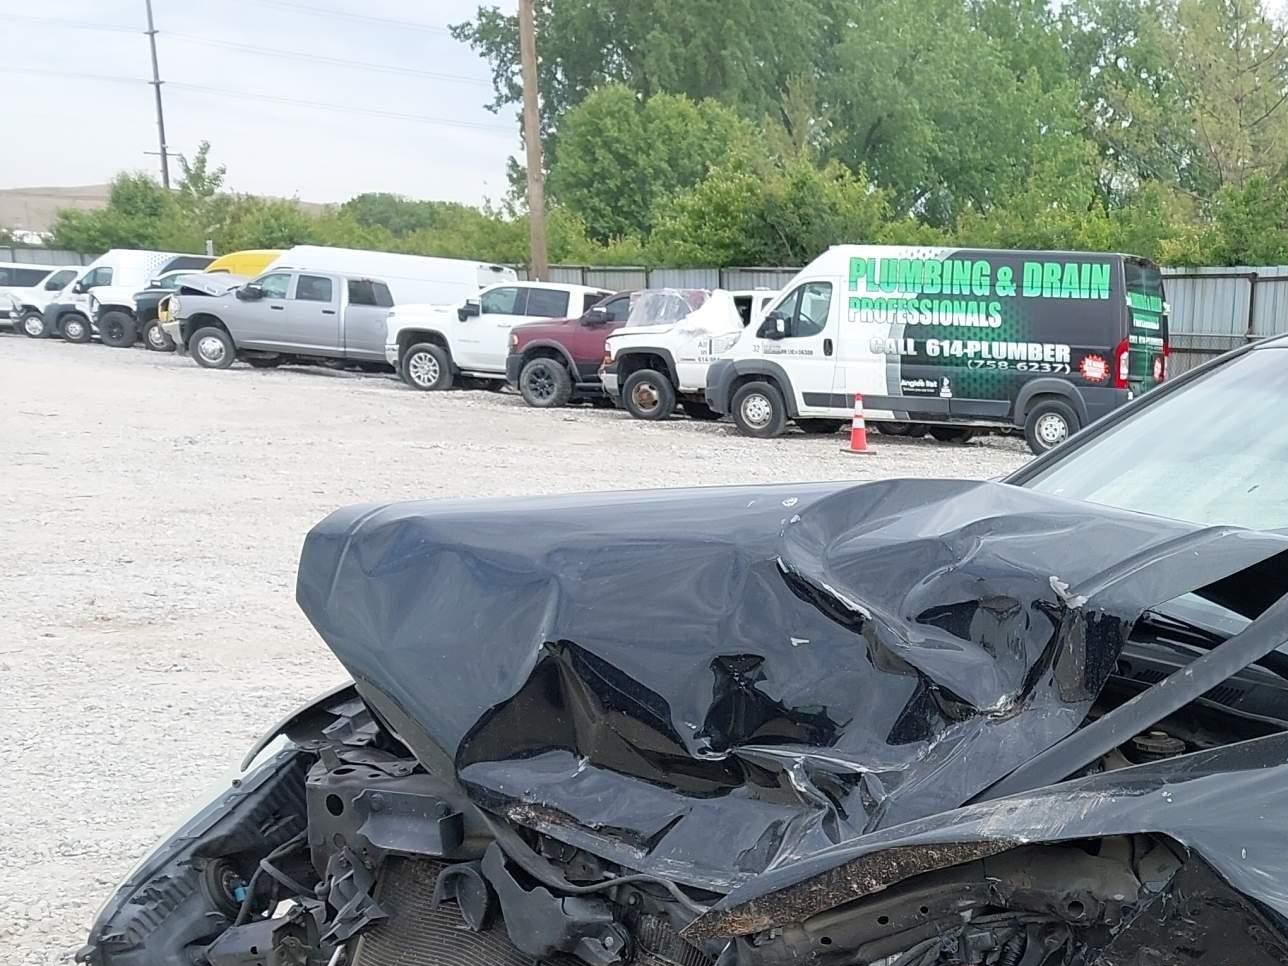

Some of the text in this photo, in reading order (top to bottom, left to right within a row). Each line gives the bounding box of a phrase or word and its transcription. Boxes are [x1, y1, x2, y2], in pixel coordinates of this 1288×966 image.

[848, 256, 1111, 299] PLUMBING & DRAIN
[848, 297, 1002, 328] PROFESSIONALS
[869, 337, 1070, 363] CALL 614-PLUMBER
[967, 359, 1071, 374] (758-6237)
